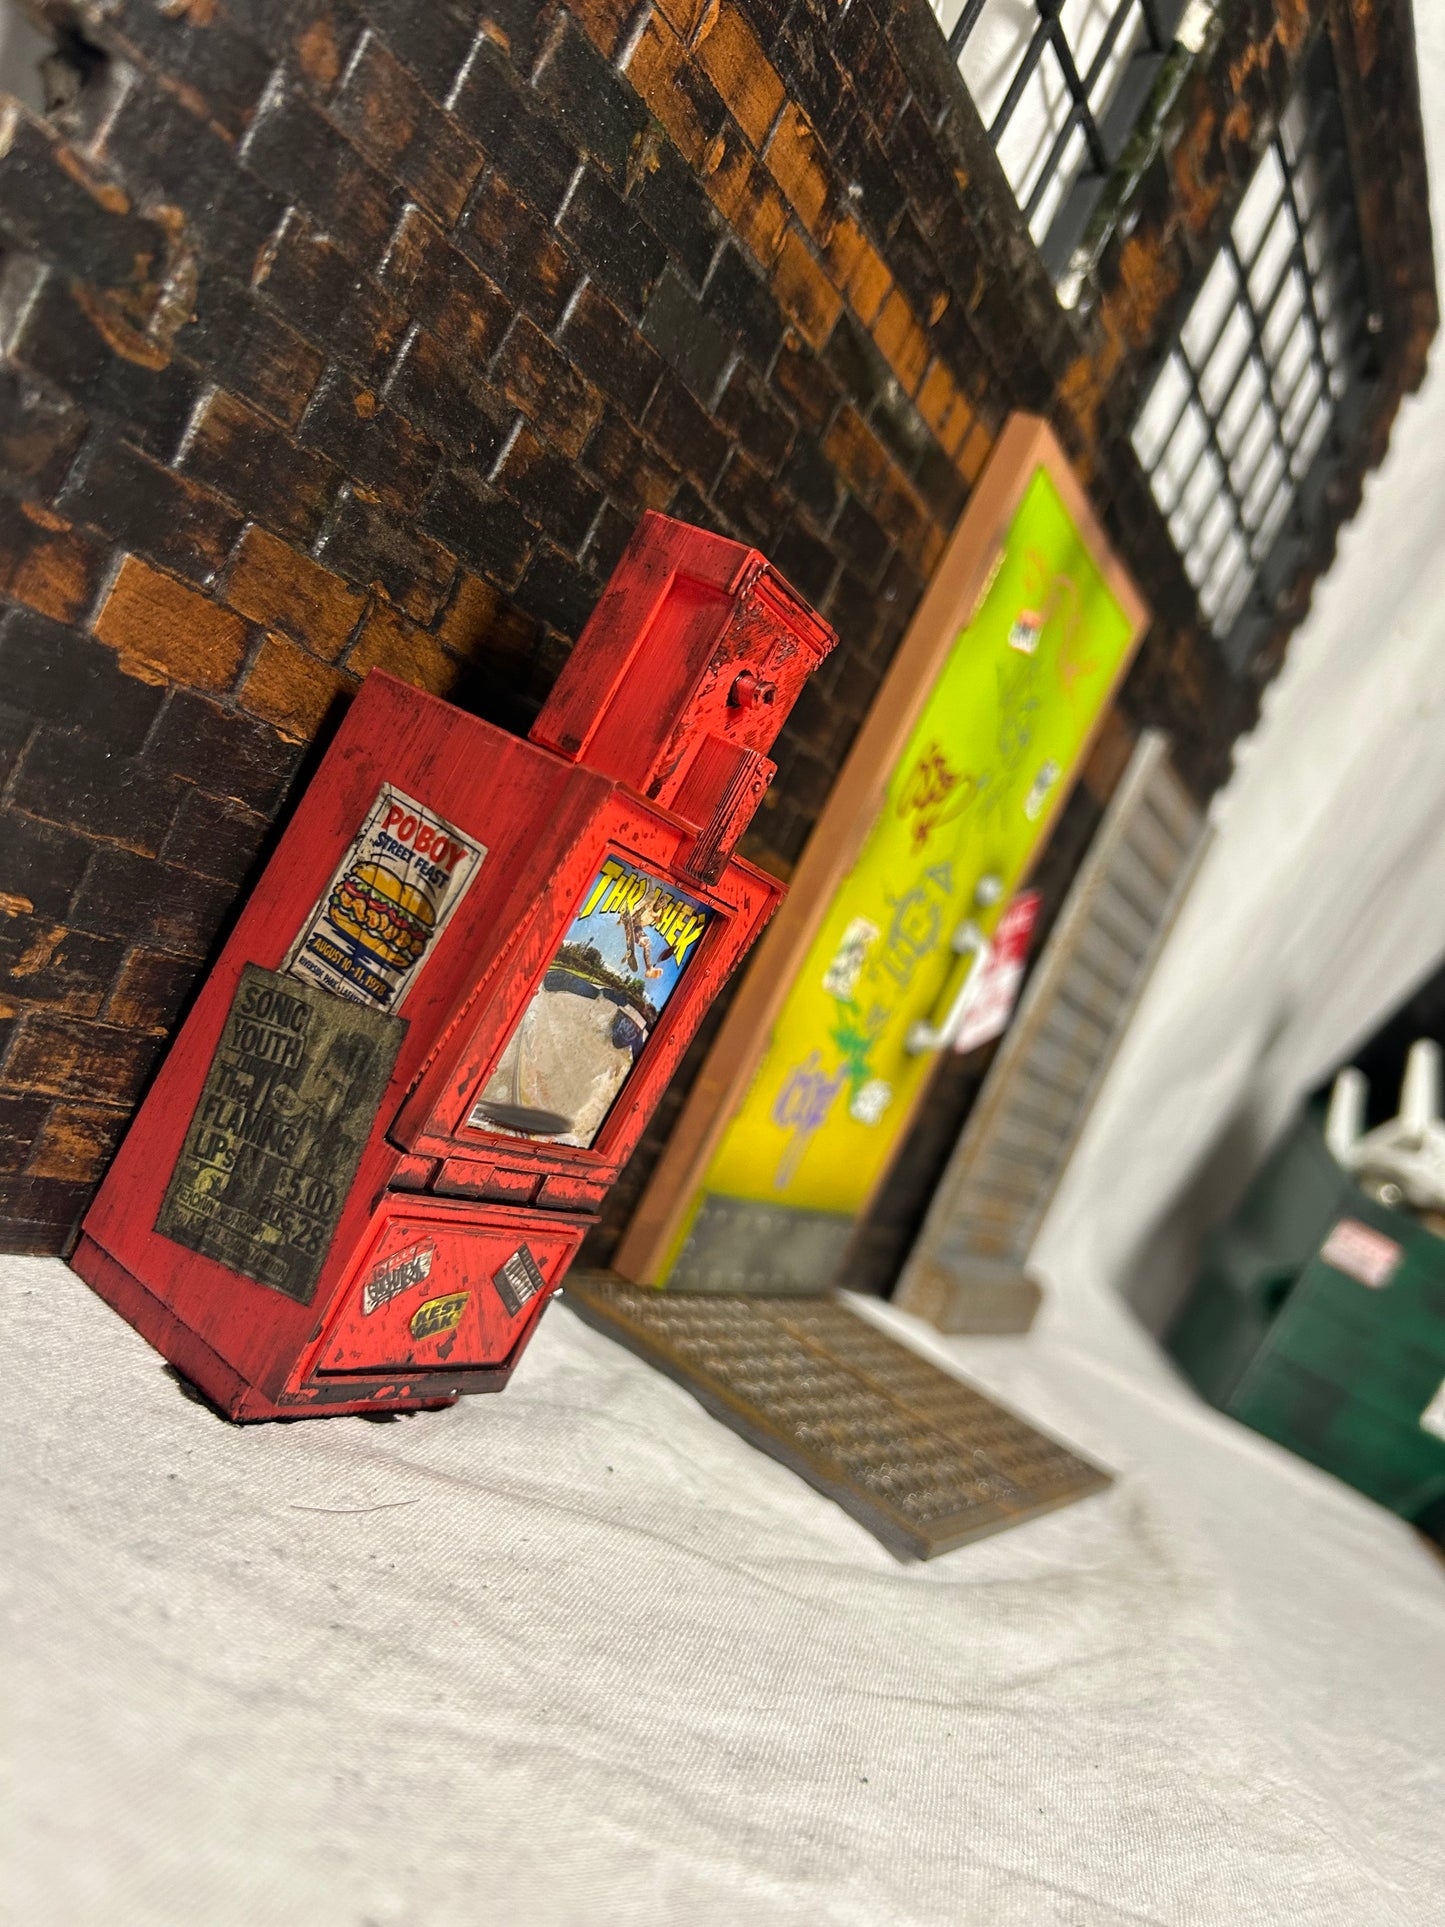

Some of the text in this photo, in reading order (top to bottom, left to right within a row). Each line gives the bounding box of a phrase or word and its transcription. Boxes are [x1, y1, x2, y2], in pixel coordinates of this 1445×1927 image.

[373, 831, 450, 889] STREET FEAST
[578, 860, 705, 967] THRHER
[298, 955, 325, 979] RIVERSIDE
[322, 973, 340, 989] PARK
[312, 938, 345, 965] AUGUST
[364, 975, 387, 996] 1978
[240, 985, 307, 1031] SONIC
[231, 1020, 303, 1068] YOUTH
[219, 1066, 250, 1102] The
[202, 1099, 299, 1157] FLAMING
[278, 1168, 336, 1214] $5.00
[291, 1212, 325, 1254] 28
